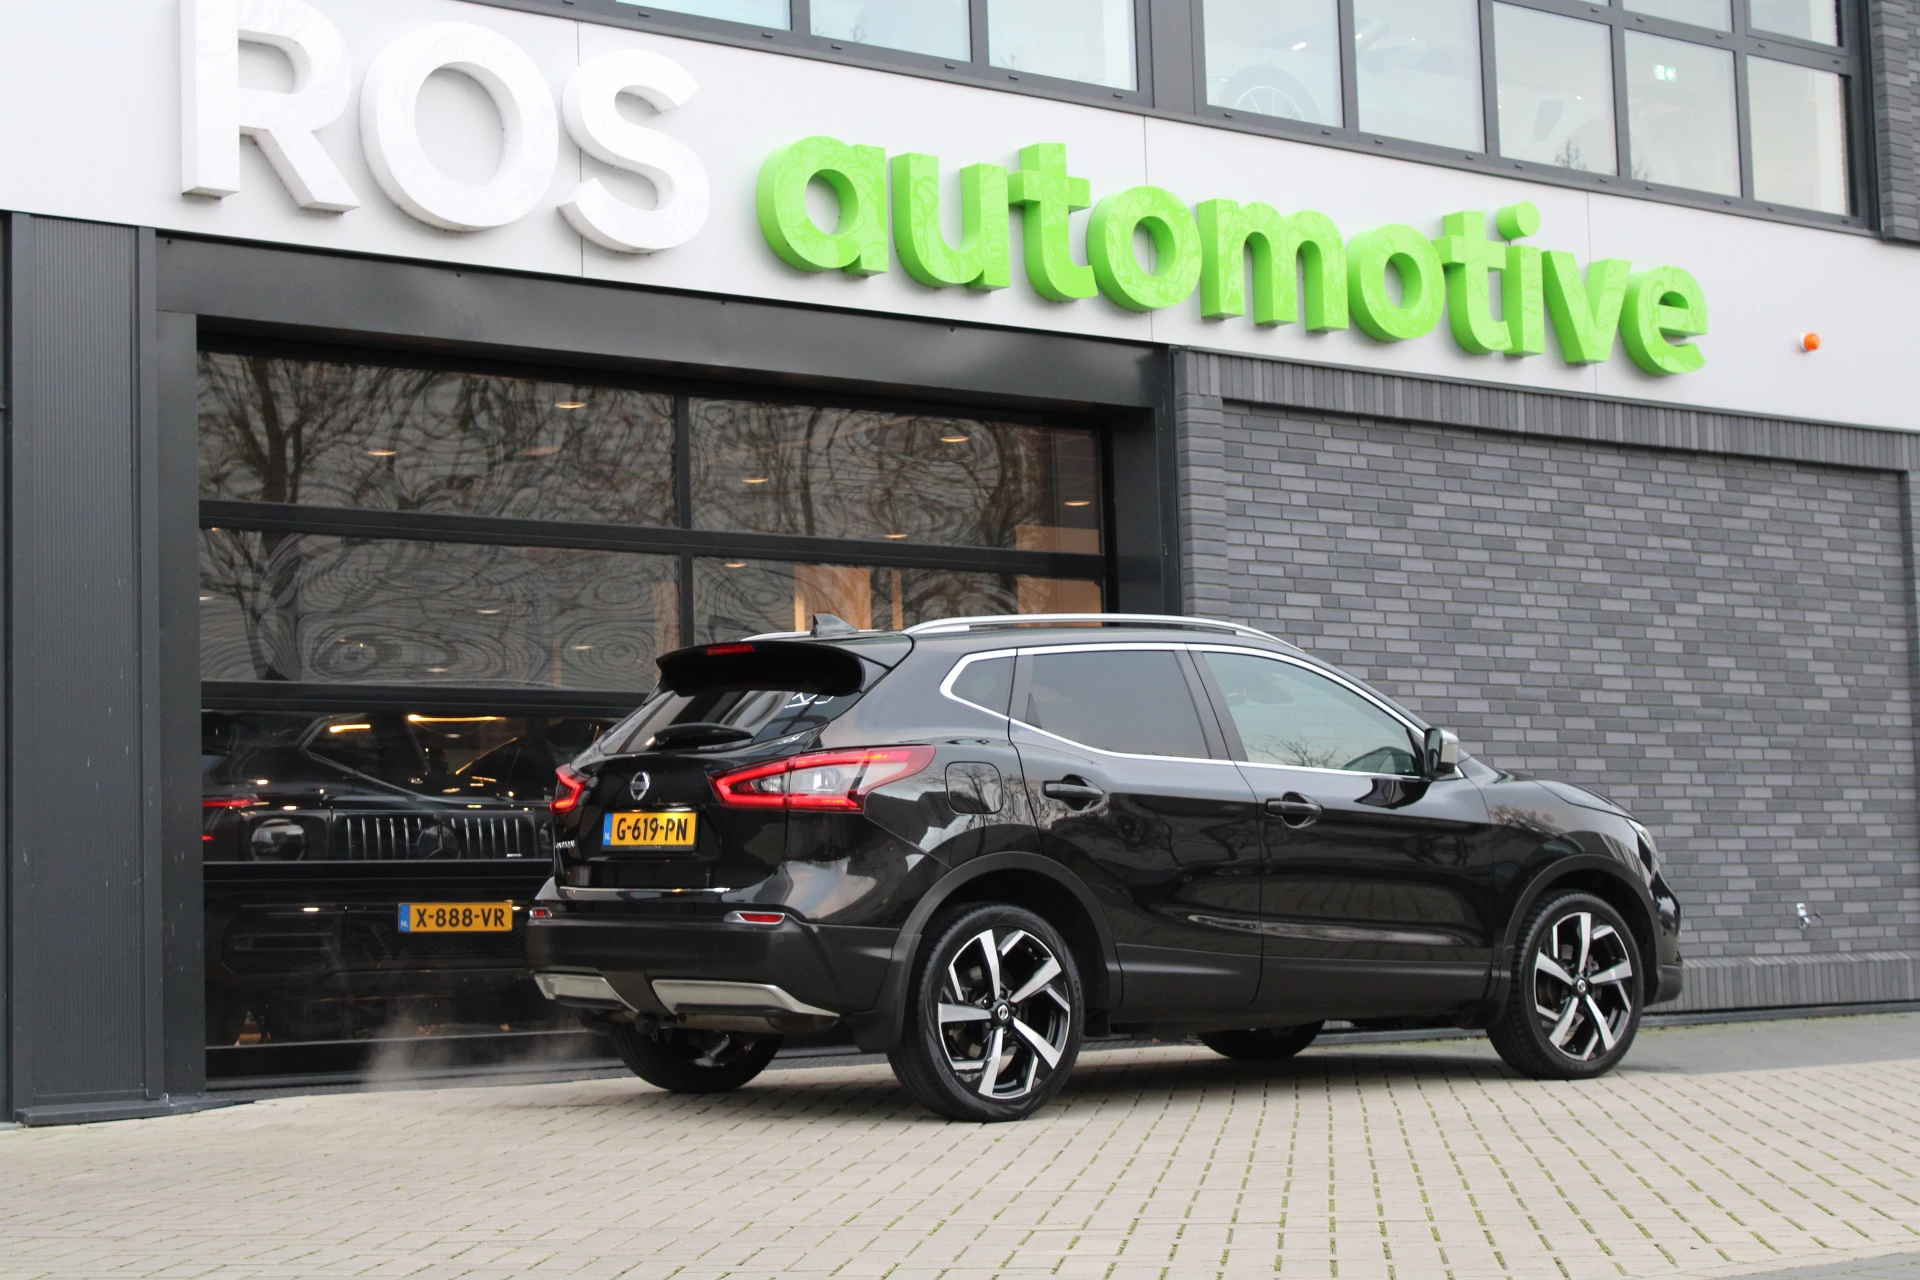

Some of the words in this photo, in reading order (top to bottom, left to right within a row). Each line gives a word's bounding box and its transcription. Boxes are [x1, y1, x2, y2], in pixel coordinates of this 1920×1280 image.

[181, 0, 710, 254] ROS
[756, 135, 1708, 377] automotive
[616, 817, 689, 842] G-619-PN
[416, 907, 505, 928] X-888-VR
